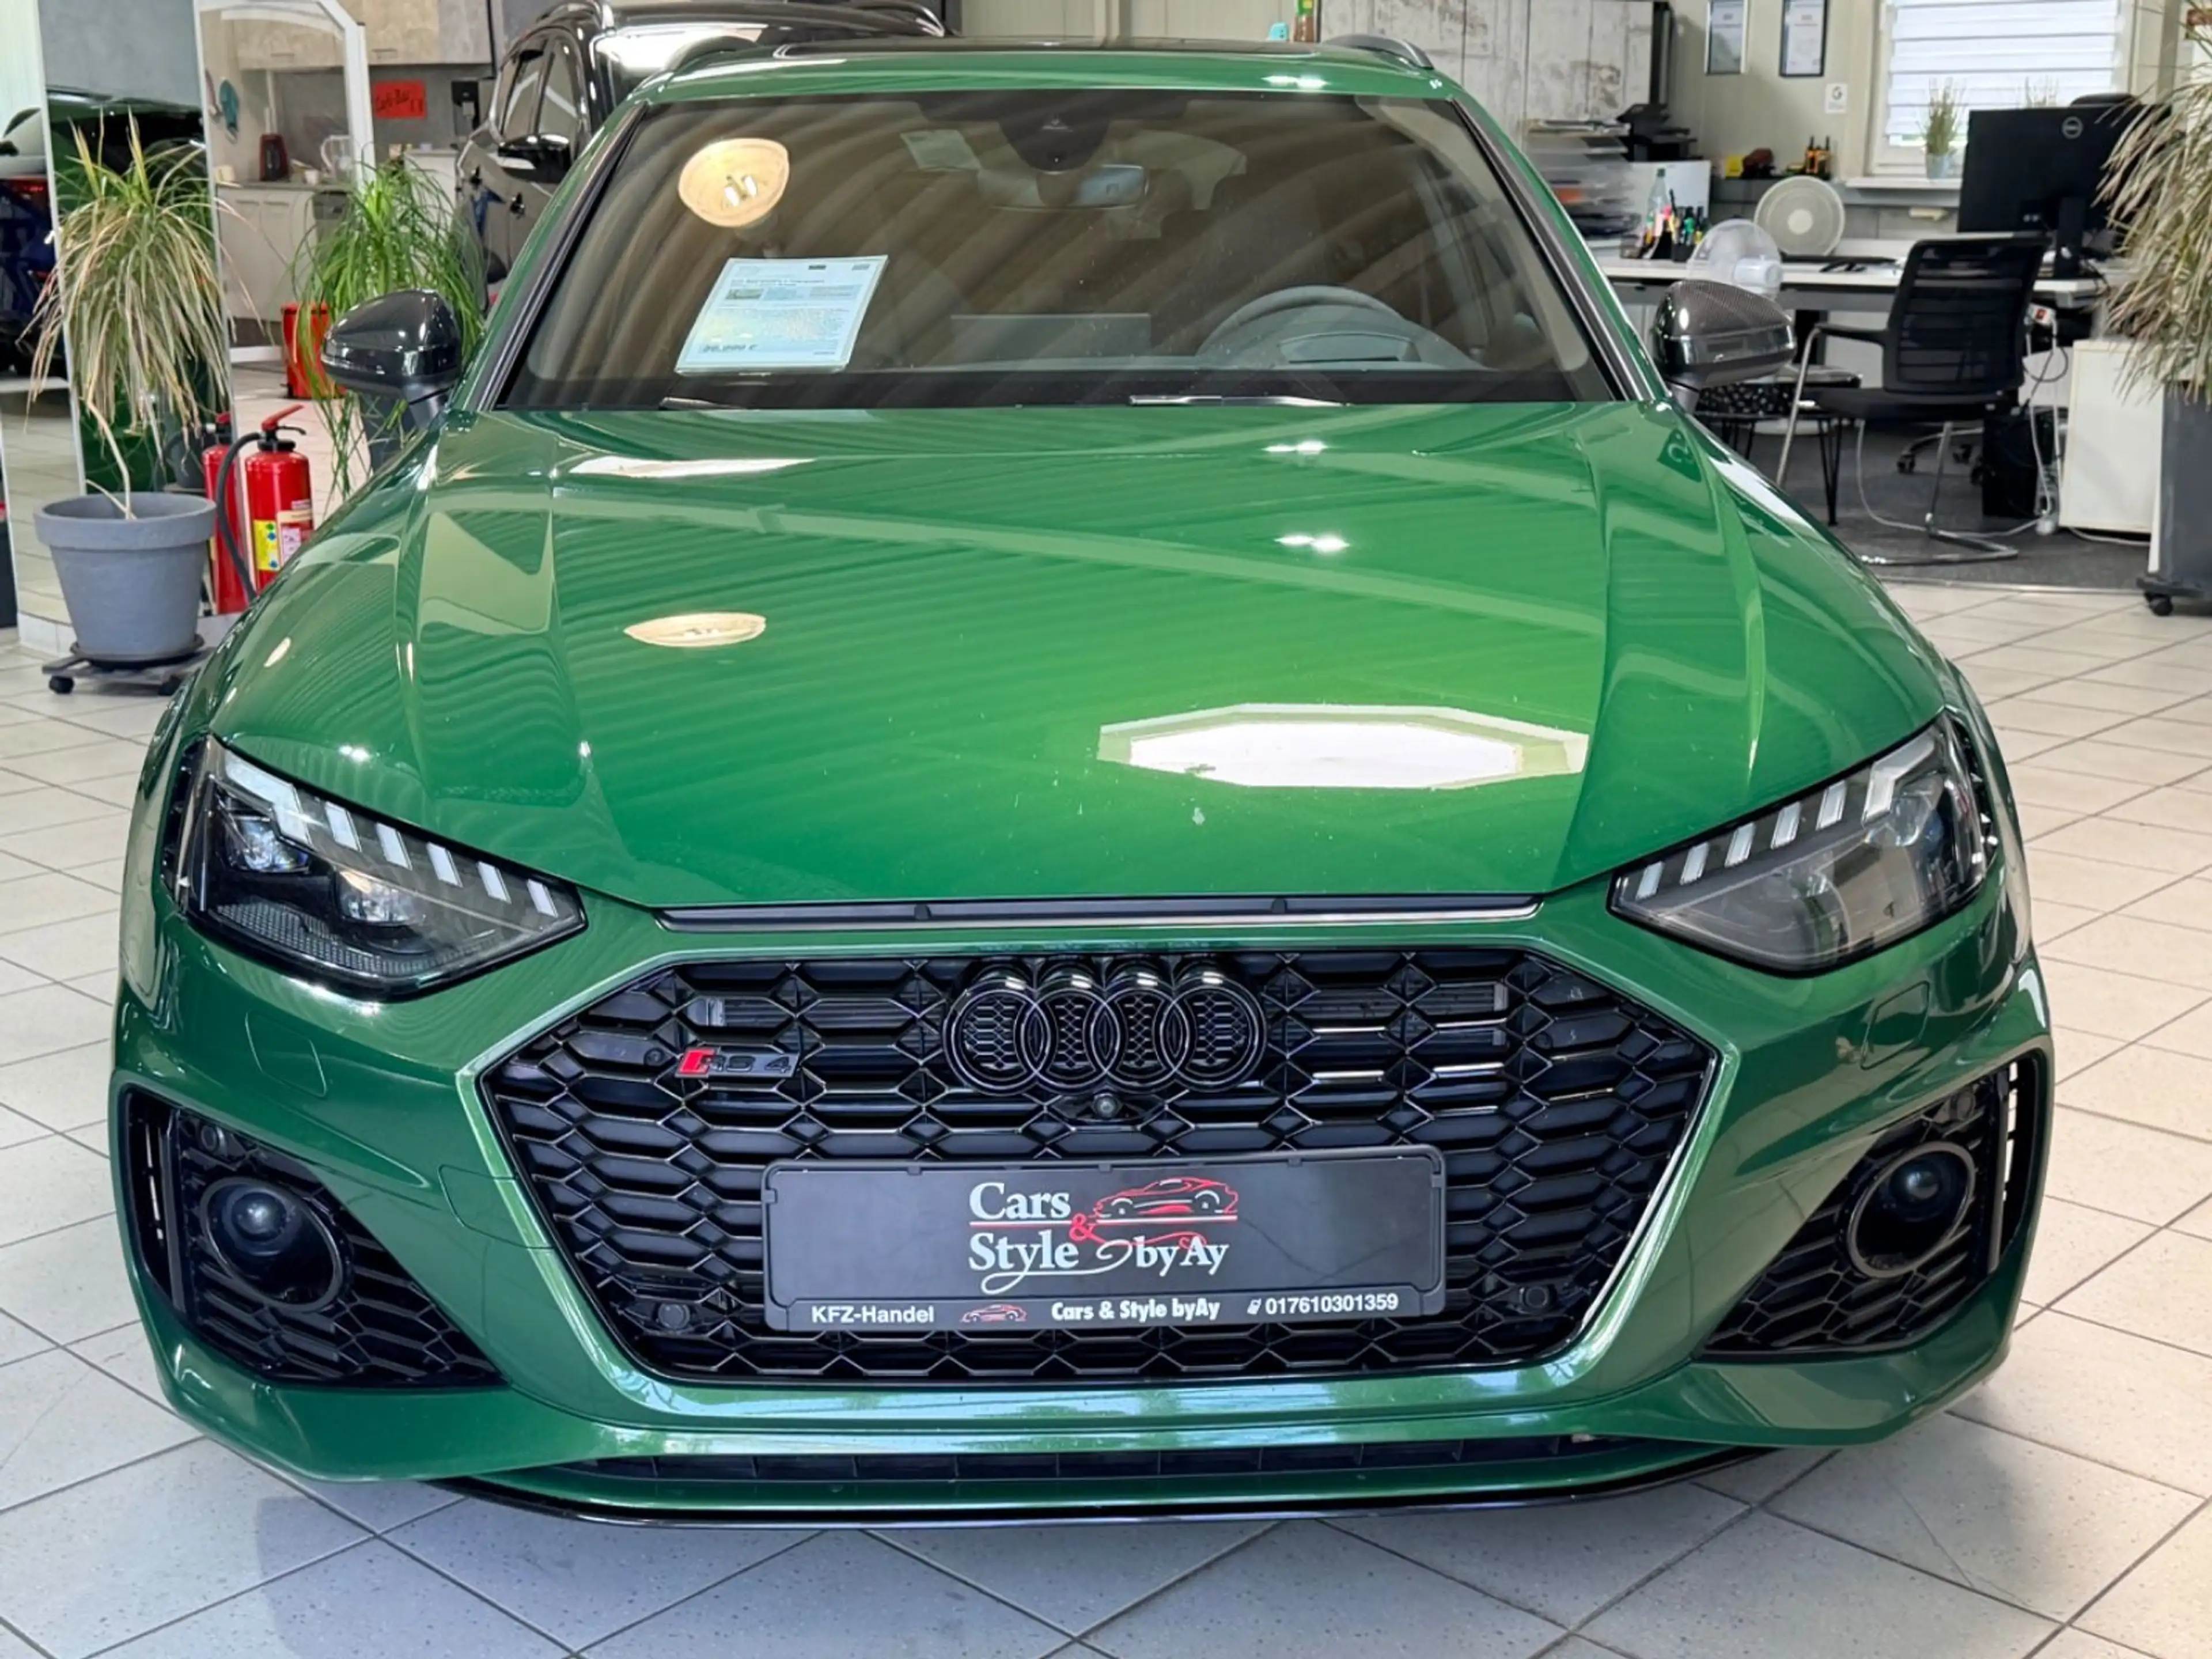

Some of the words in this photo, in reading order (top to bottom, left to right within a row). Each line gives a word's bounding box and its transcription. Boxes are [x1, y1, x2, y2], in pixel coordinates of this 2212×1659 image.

[969, 1182, 1071, 1220] Cars
[1069, 1213, 1096, 1241] &
[968, 1229, 1080, 1296] Style
[812, 1305, 934, 1324] KFZ-Handel
[1051, 1302, 1094, 1320] Cars
[1099, 1300, 1115, 1319] &
[1119, 1298, 1168, 1323] Style
[1172, 1298, 1221, 1321] byAy
[1265, 1293, 1399, 1315] 017610301359
